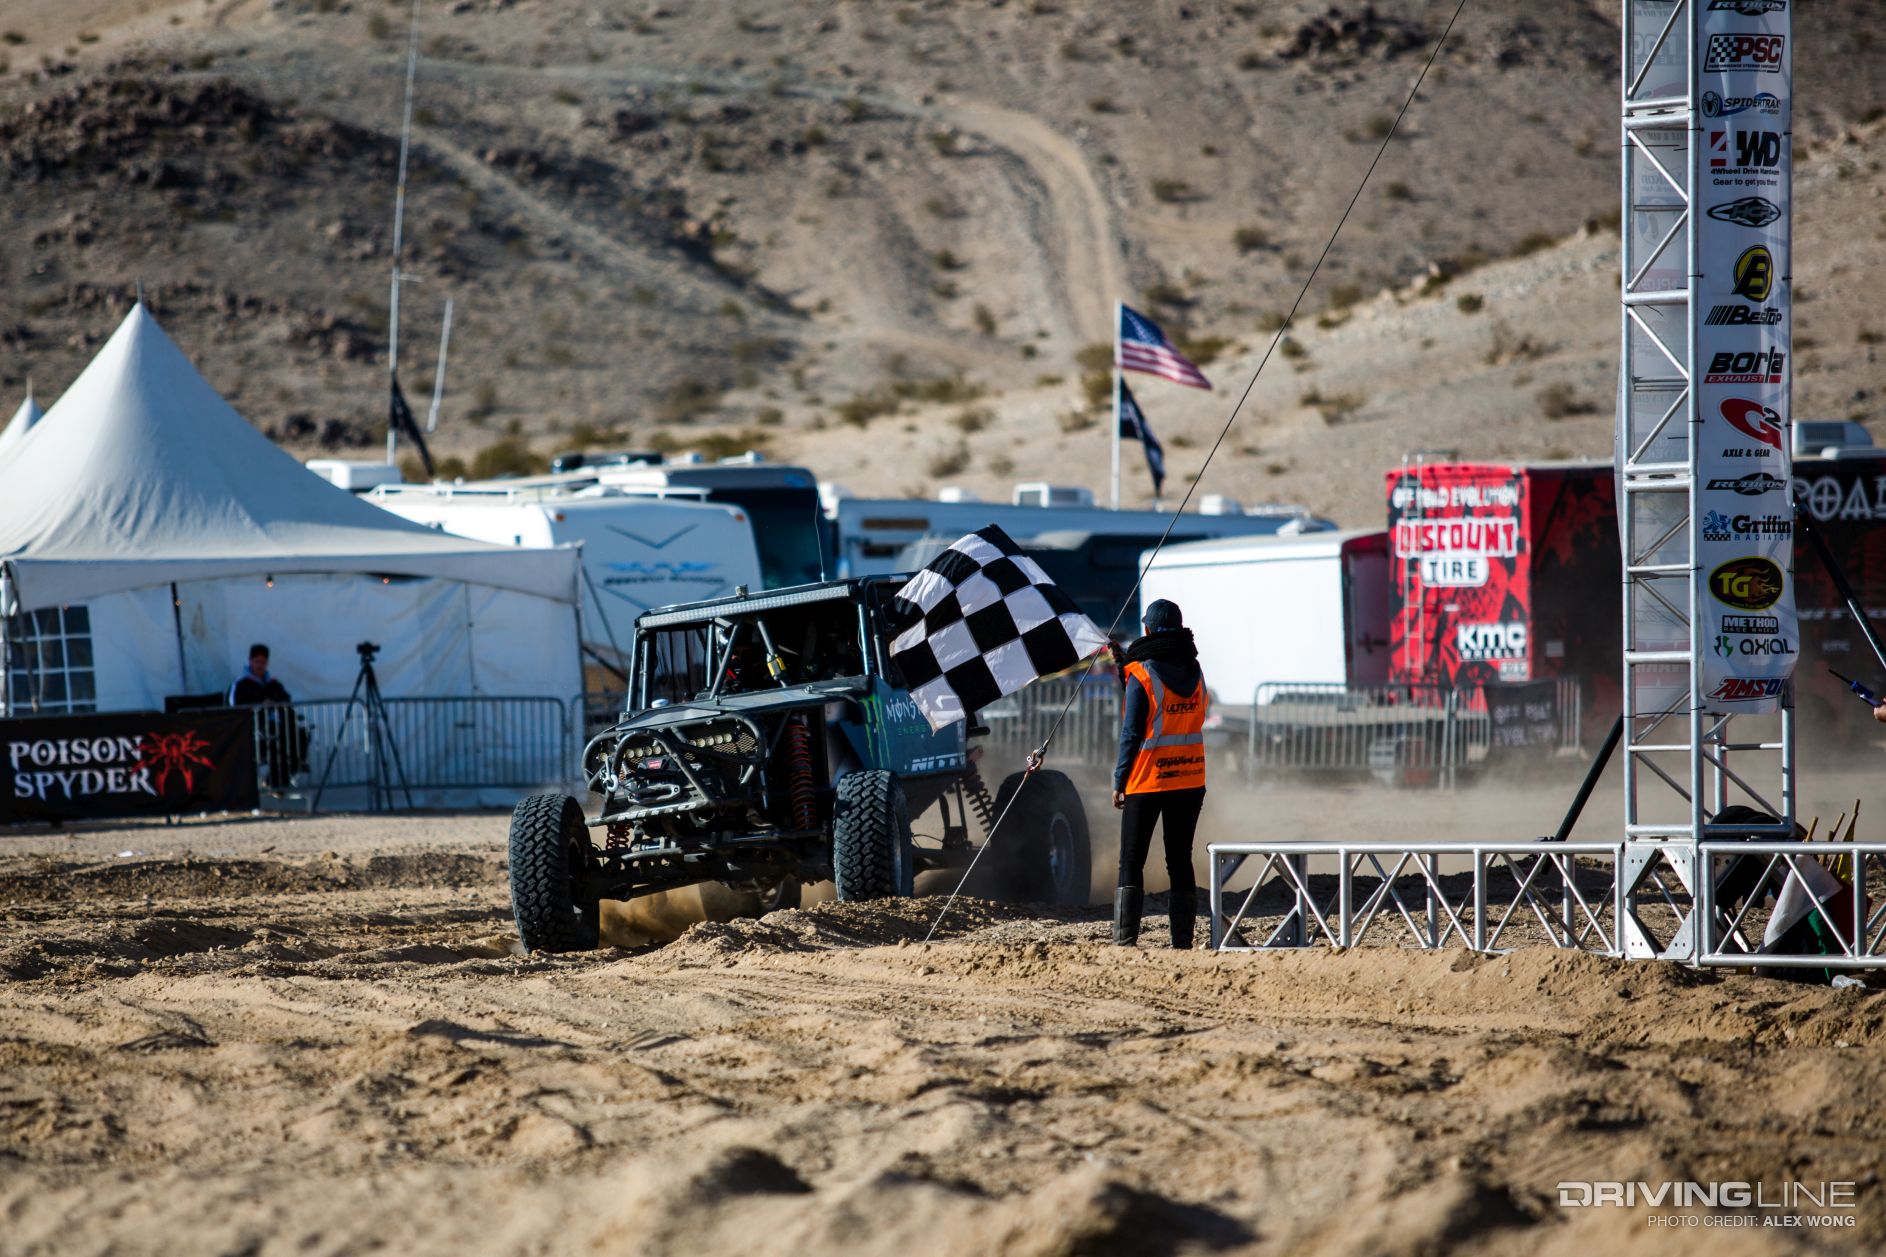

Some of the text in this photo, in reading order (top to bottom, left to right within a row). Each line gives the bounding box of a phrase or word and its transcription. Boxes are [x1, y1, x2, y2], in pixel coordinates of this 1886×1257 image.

[1736, 37, 1781, 63] PSC
[1713, 178, 1732, 186] Gear
[1708, 375, 1763, 383] EXHAUST
[1722, 449, 1771, 457] AXLE & GEAR
[1732, 515, 1791, 533] Griffin
[1398, 522, 1516, 552] DISCOUNT
[1428, 560, 1478, 579] TIRE
[1717, 573, 1753, 598] TG
[1724, 617, 1777, 628] METHOD
[886, 698, 920, 722] MONS
[8, 735, 144, 771] POISON
[14, 767, 157, 801] SPYDER
